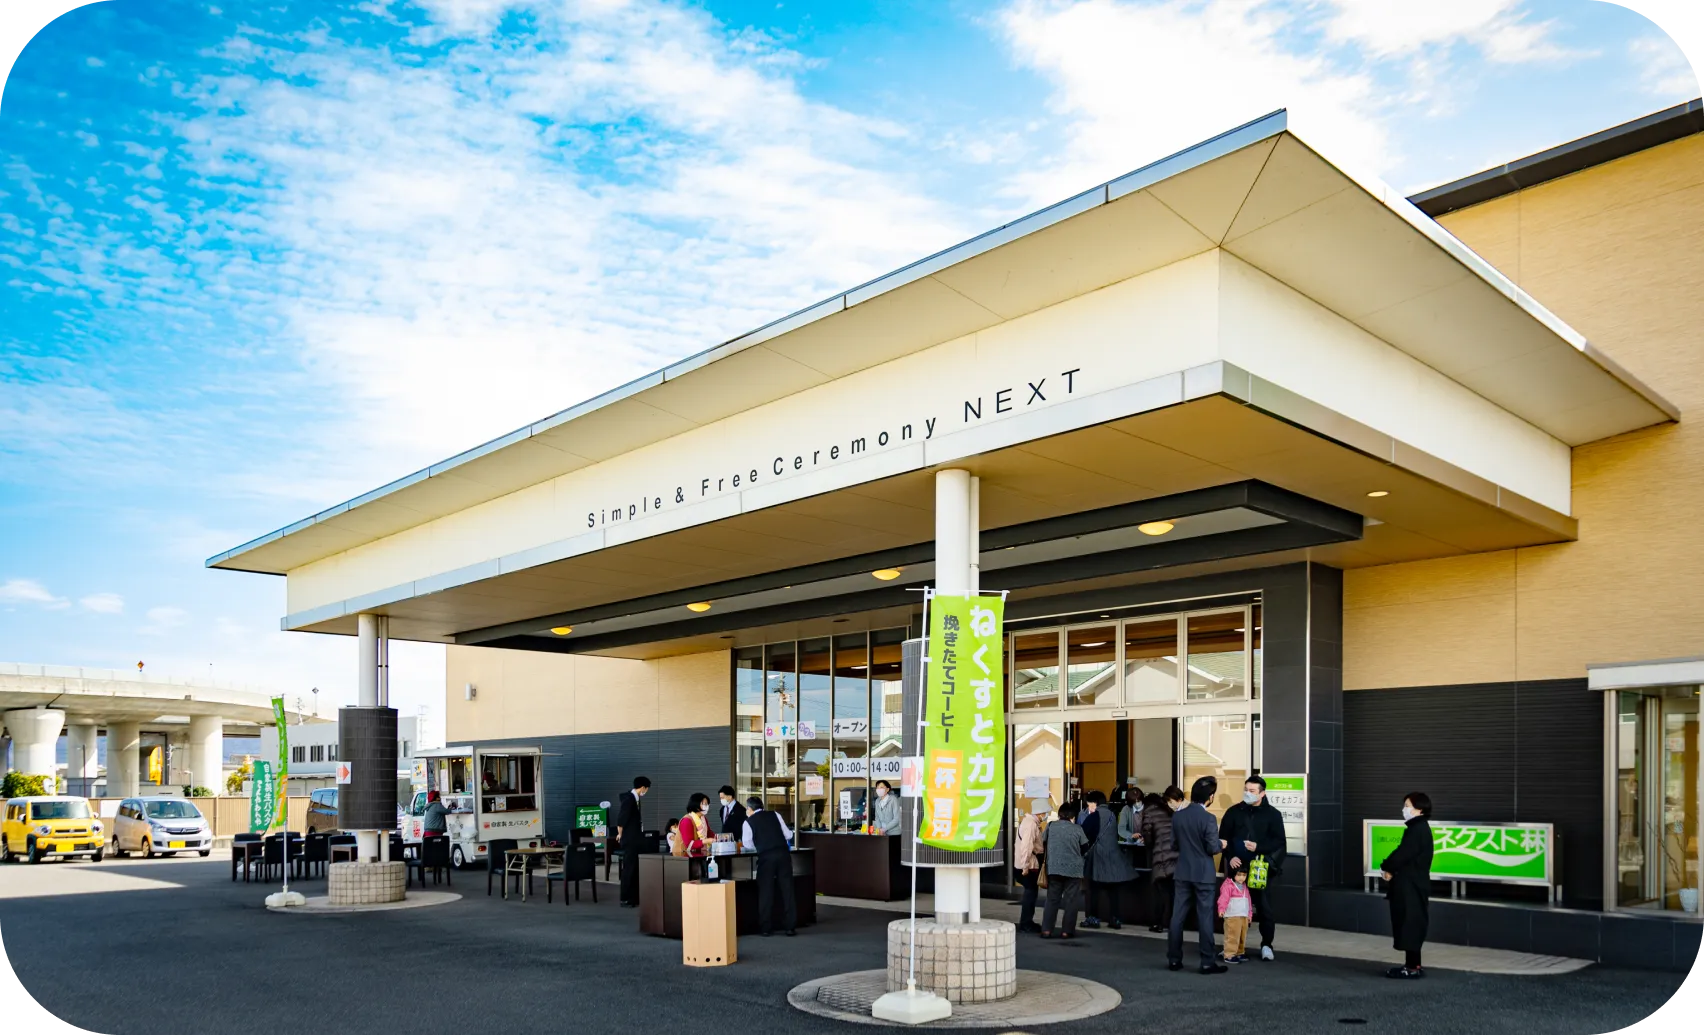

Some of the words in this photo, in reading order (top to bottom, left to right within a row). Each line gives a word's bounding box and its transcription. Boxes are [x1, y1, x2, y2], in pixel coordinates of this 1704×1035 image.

[587, 495, 663, 530] Simple
[674, 485, 685, 503] &
[700, 466, 758, 497] Free
[772, 416, 937, 476] Ceremony
[963, 367, 1082, 423] NEXT
[941, 614, 960, 743] 挽きたてコーヒー
[766, 725, 796, 736] ねくすと
[834, 721, 867, 733] オープン
[965, 605, 996, 840] ねくすとカフェ
[934, 757, 956, 788] 一杯
[932, 797, 954, 837] 百円
[1270, 796, 1303, 804] くすとカフェ
